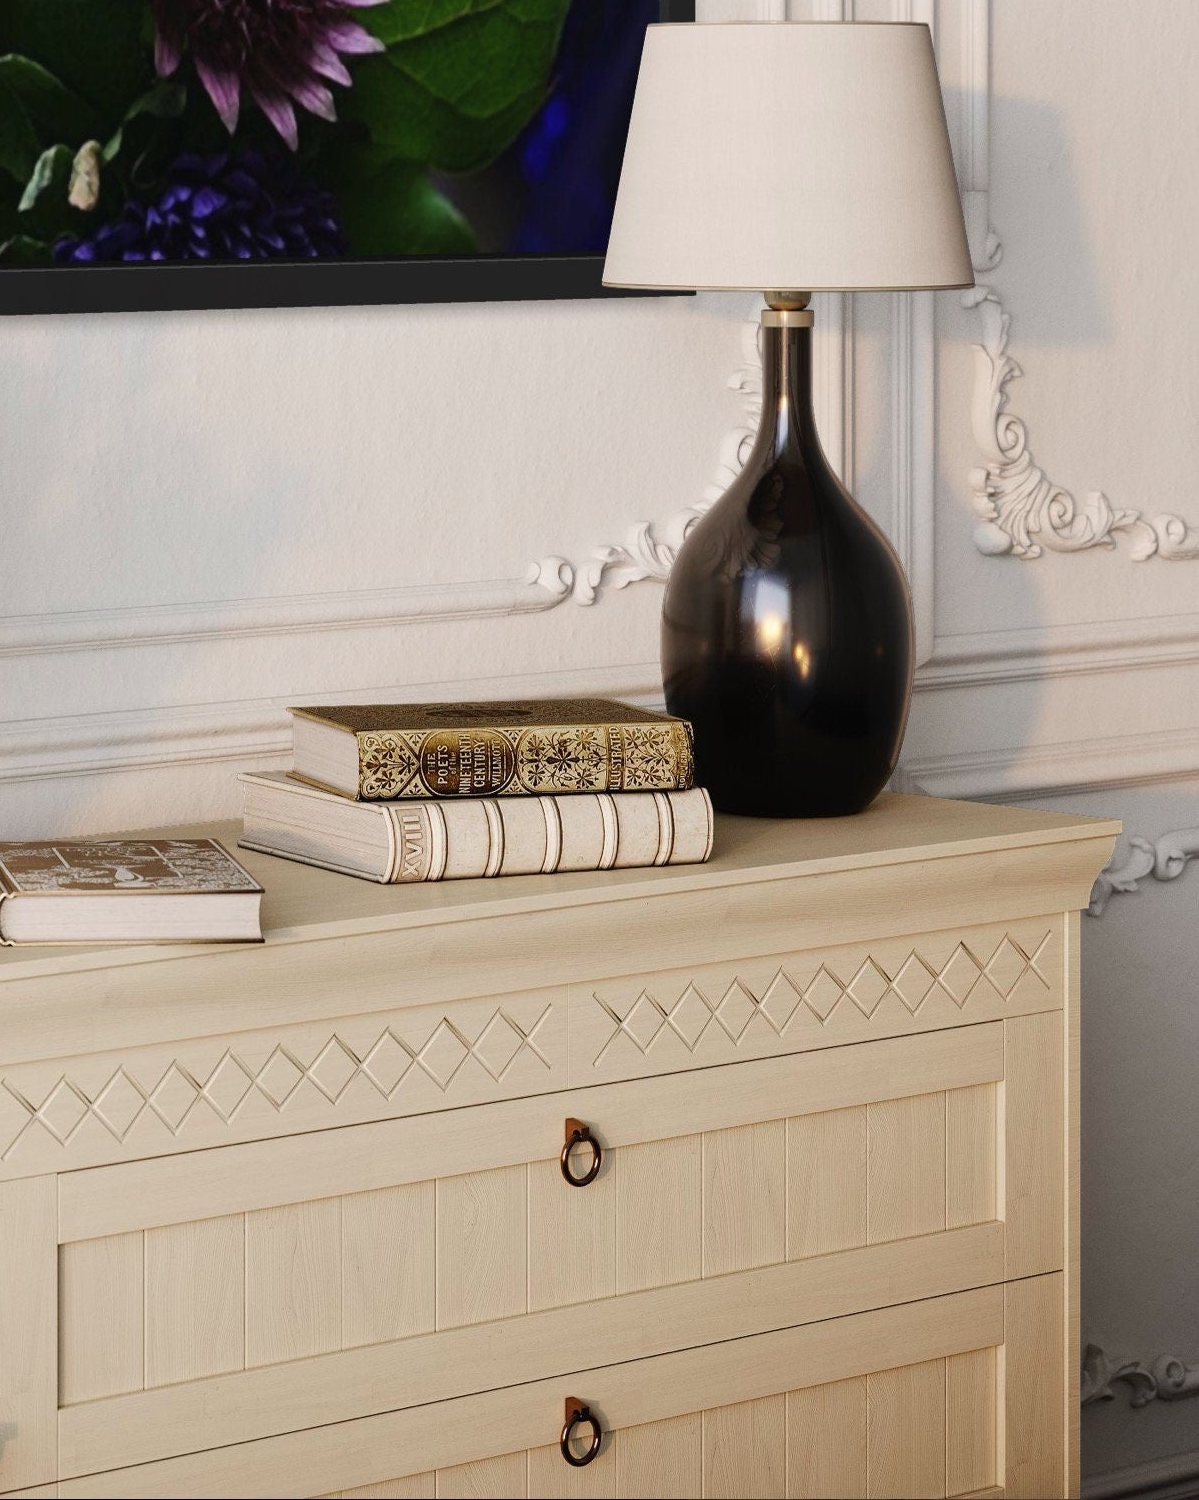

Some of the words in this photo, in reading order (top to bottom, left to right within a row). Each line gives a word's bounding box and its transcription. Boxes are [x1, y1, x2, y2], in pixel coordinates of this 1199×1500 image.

[427, 753, 436, 774] THE
[437, 745, 448, 784] POETS
[448, 752, 457, 765] the
[448, 766, 457, 775] of
[459, 733, 472, 794] NINETEENTH
[491, 740, 502, 787] WILLMOTT
[609, 726, 622, 790] ILLUSTRATED
[402, 815, 423, 877] XVIII
